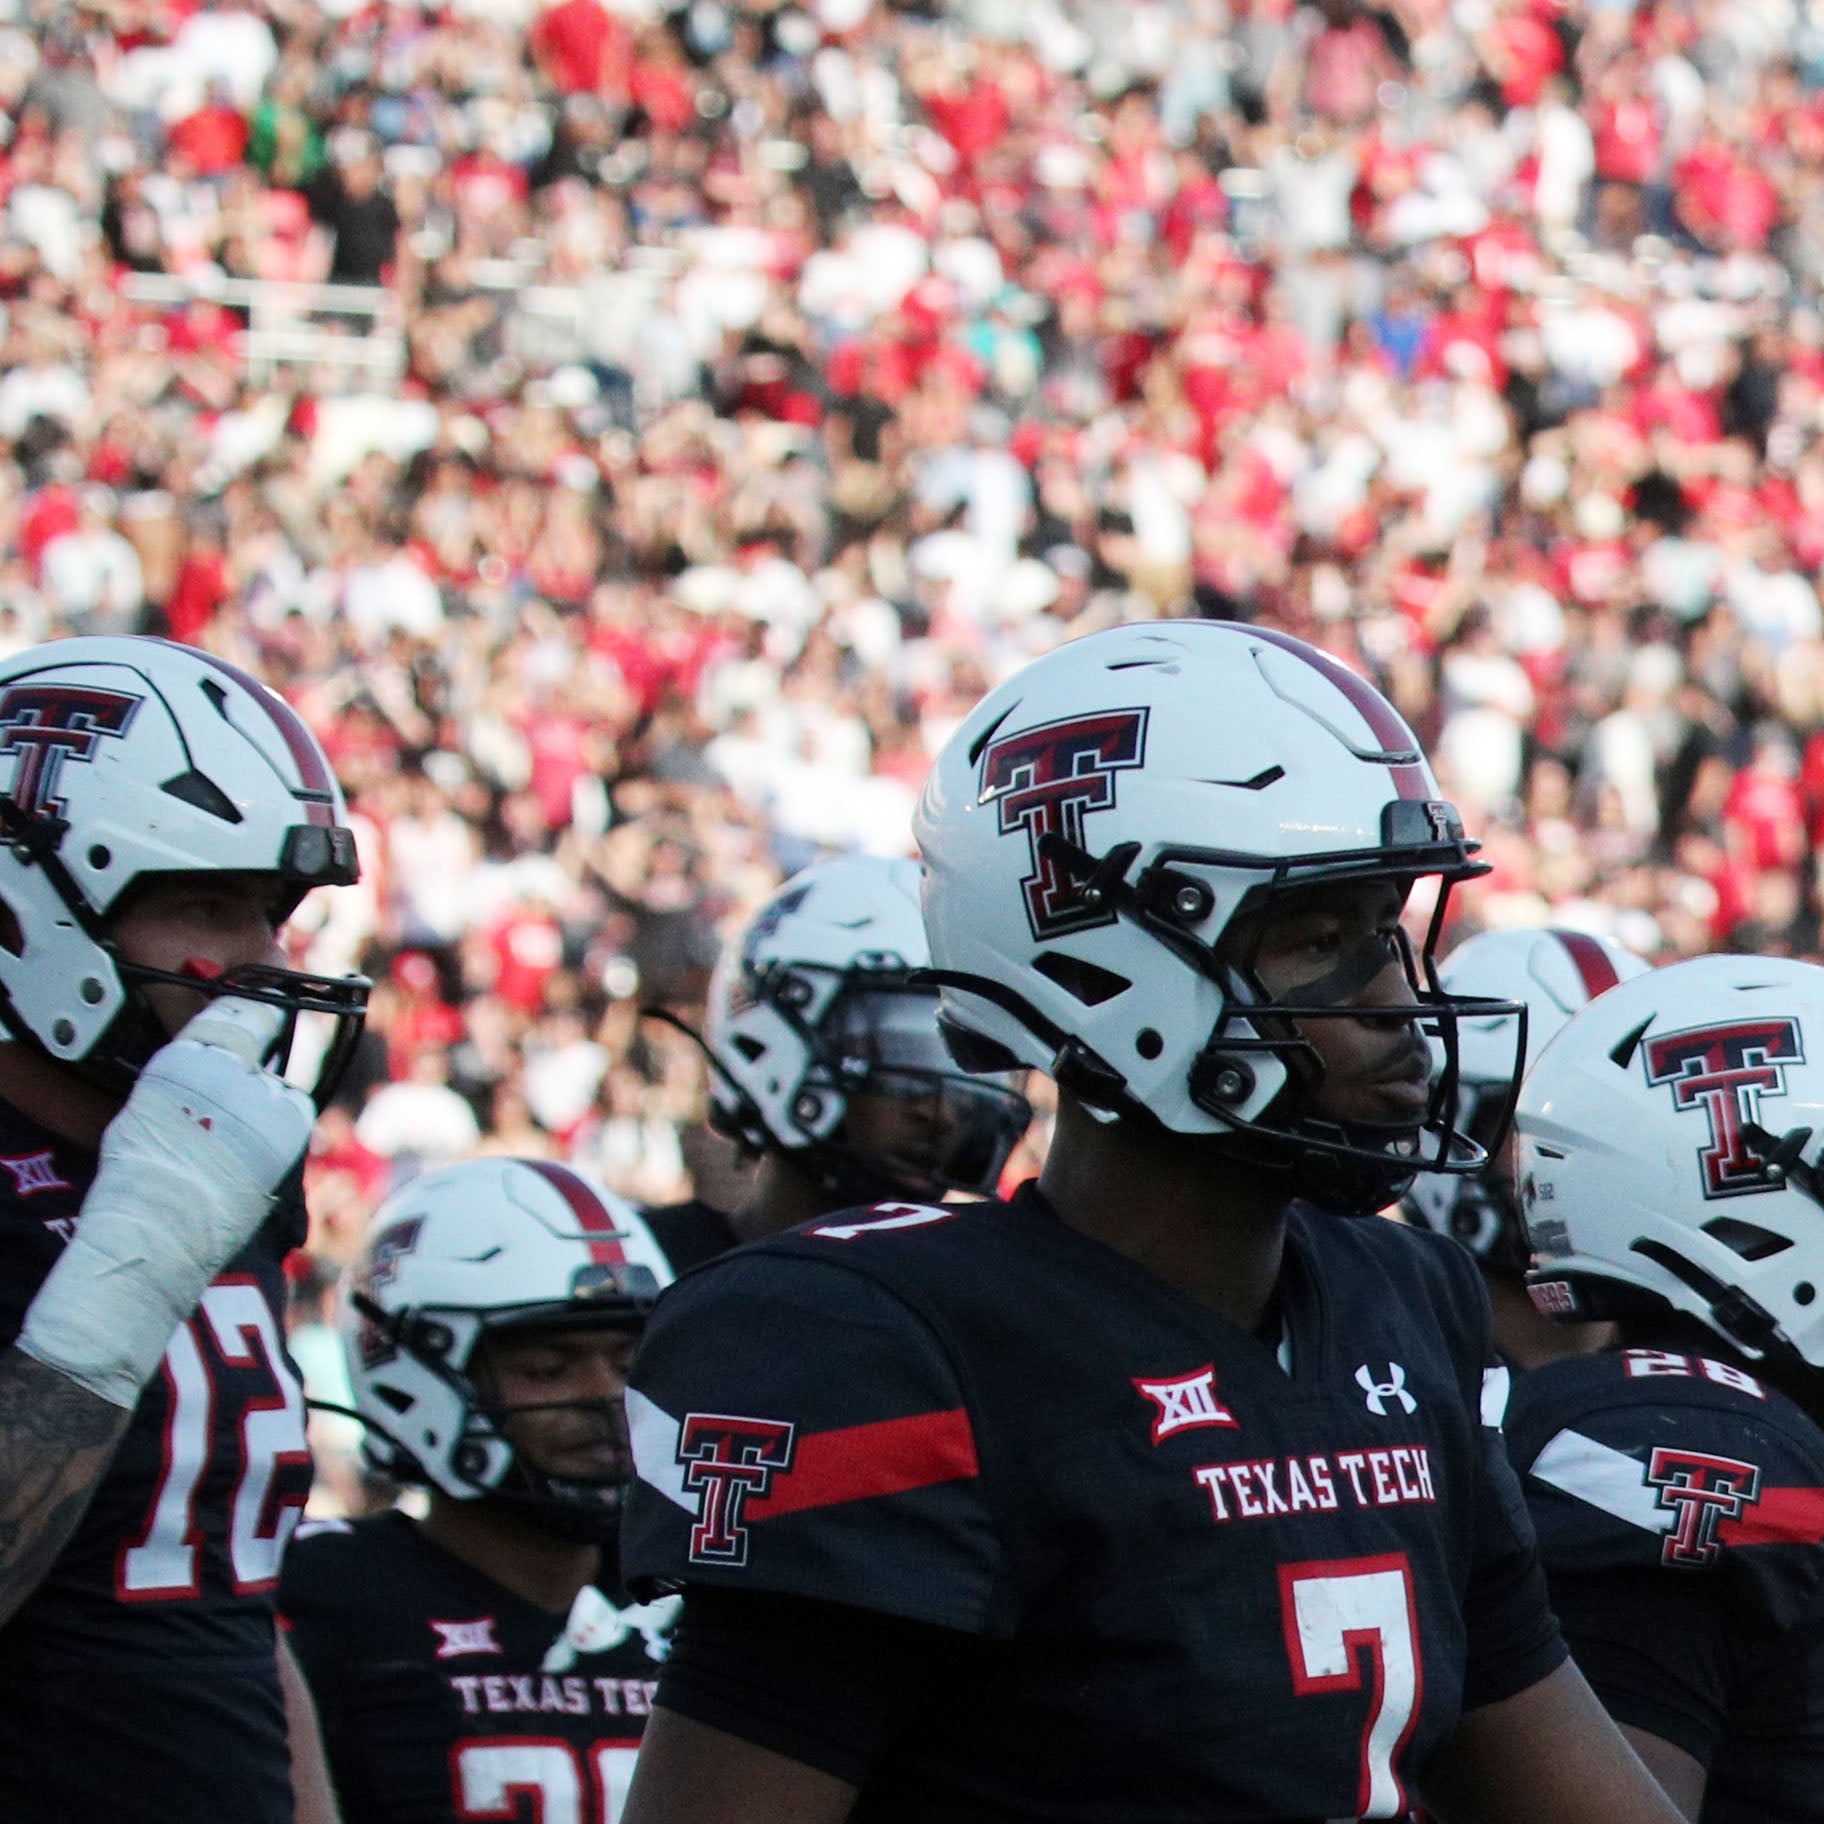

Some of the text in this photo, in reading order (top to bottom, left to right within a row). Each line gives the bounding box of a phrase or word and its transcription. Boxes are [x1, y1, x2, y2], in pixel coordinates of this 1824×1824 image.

[1195, 1446, 1437, 1523] TEXAS TECH
[450, 1675, 660, 1716] TEXAS TE
